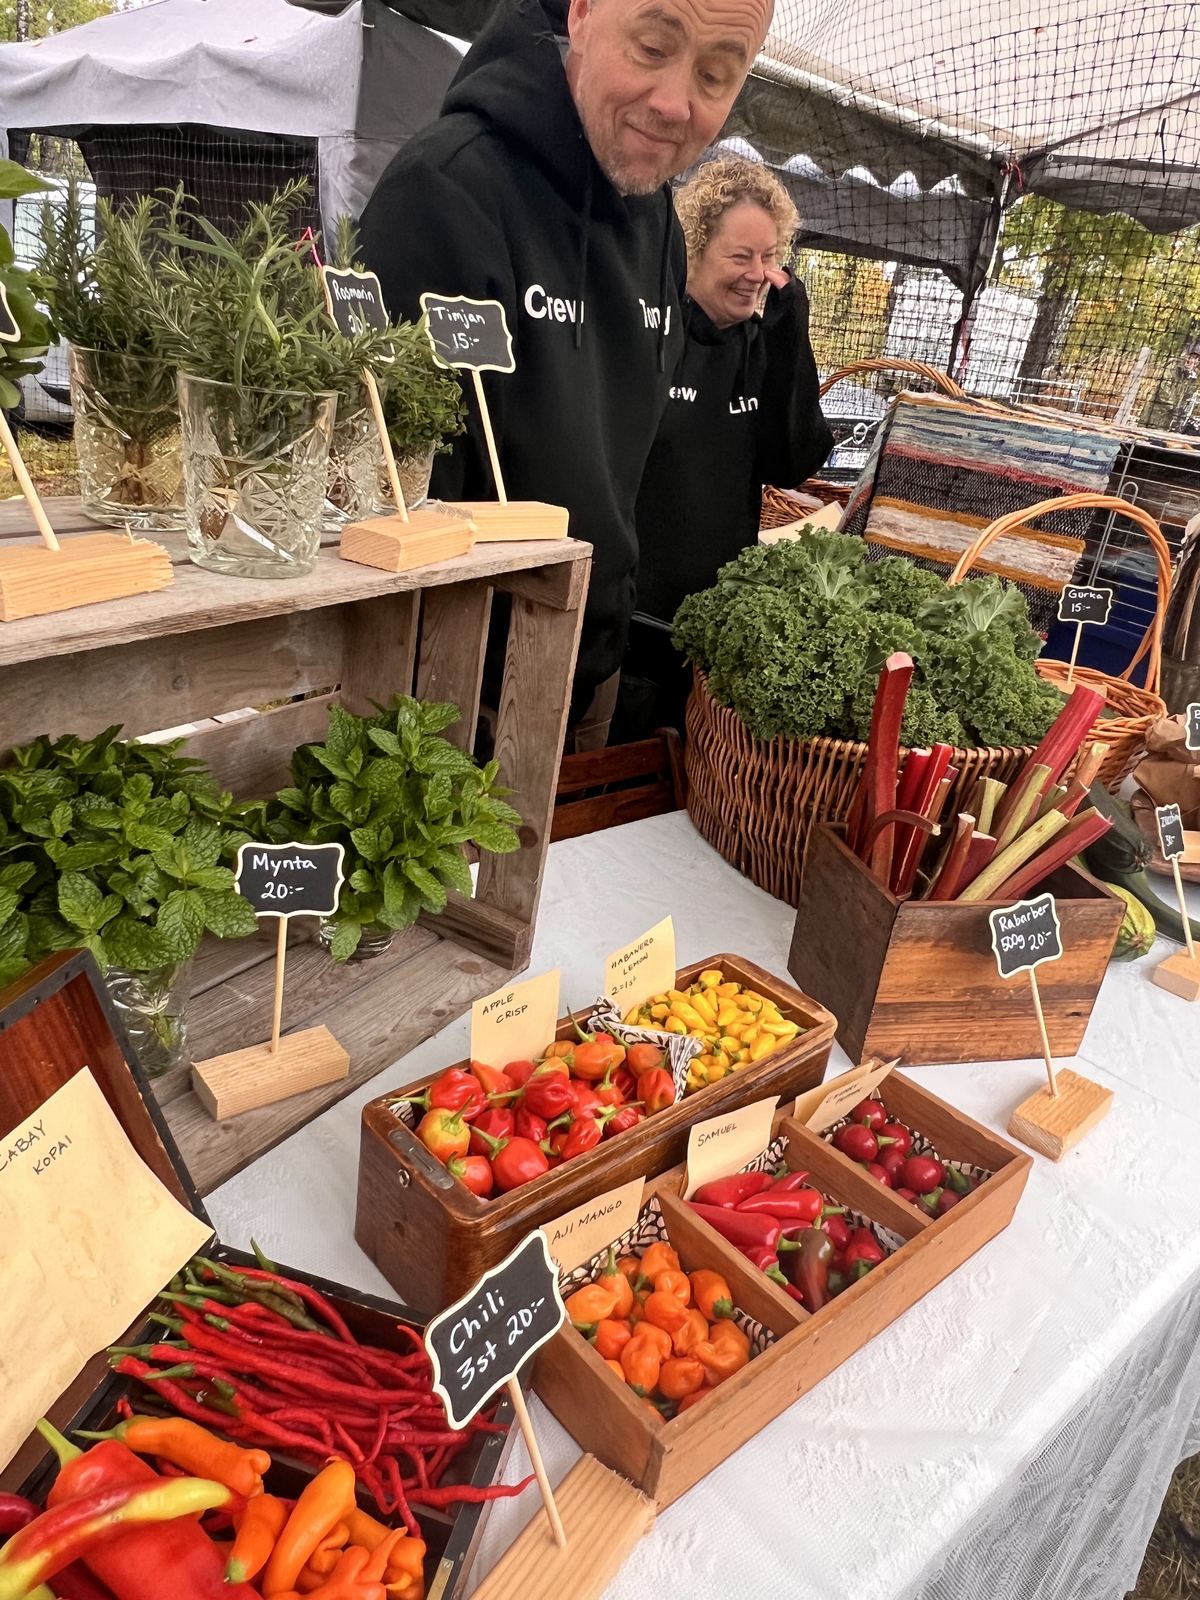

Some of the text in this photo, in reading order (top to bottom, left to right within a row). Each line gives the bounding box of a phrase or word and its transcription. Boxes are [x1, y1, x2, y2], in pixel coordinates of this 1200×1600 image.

[331, 278, 376, 304] Rosmarin
[431, 306, 486, 330] Timjan
[452, 331, 480, 350] 15:-
[668, 386, 698, 403] ew
[1068, 589, 1104, 600] Gurka
[1071, 602, 1091, 613] 15:-
[252, 852, 318, 877] Mynta
[260, 881, 305, 899] 20:-
[998, 903, 1050, 933] Rabarber
[611, 937, 654, 969] HABANERO
[1027, 931, 1052, 951] 20:-
[623, 951, 649, 976] LEMON
[482, 992, 515, 1016] APPLE
[495, 1004, 529, 1024] CRISP
[697, 1122, 738, 1148] SAMUEL
[32, 1134, 72, 1175] KOPAI
[551, 1200, 622, 1245] AJI MANGO
[449, 1288, 506, 1355] Chili
[456, 1296, 546, 1391] 3st 20:-
